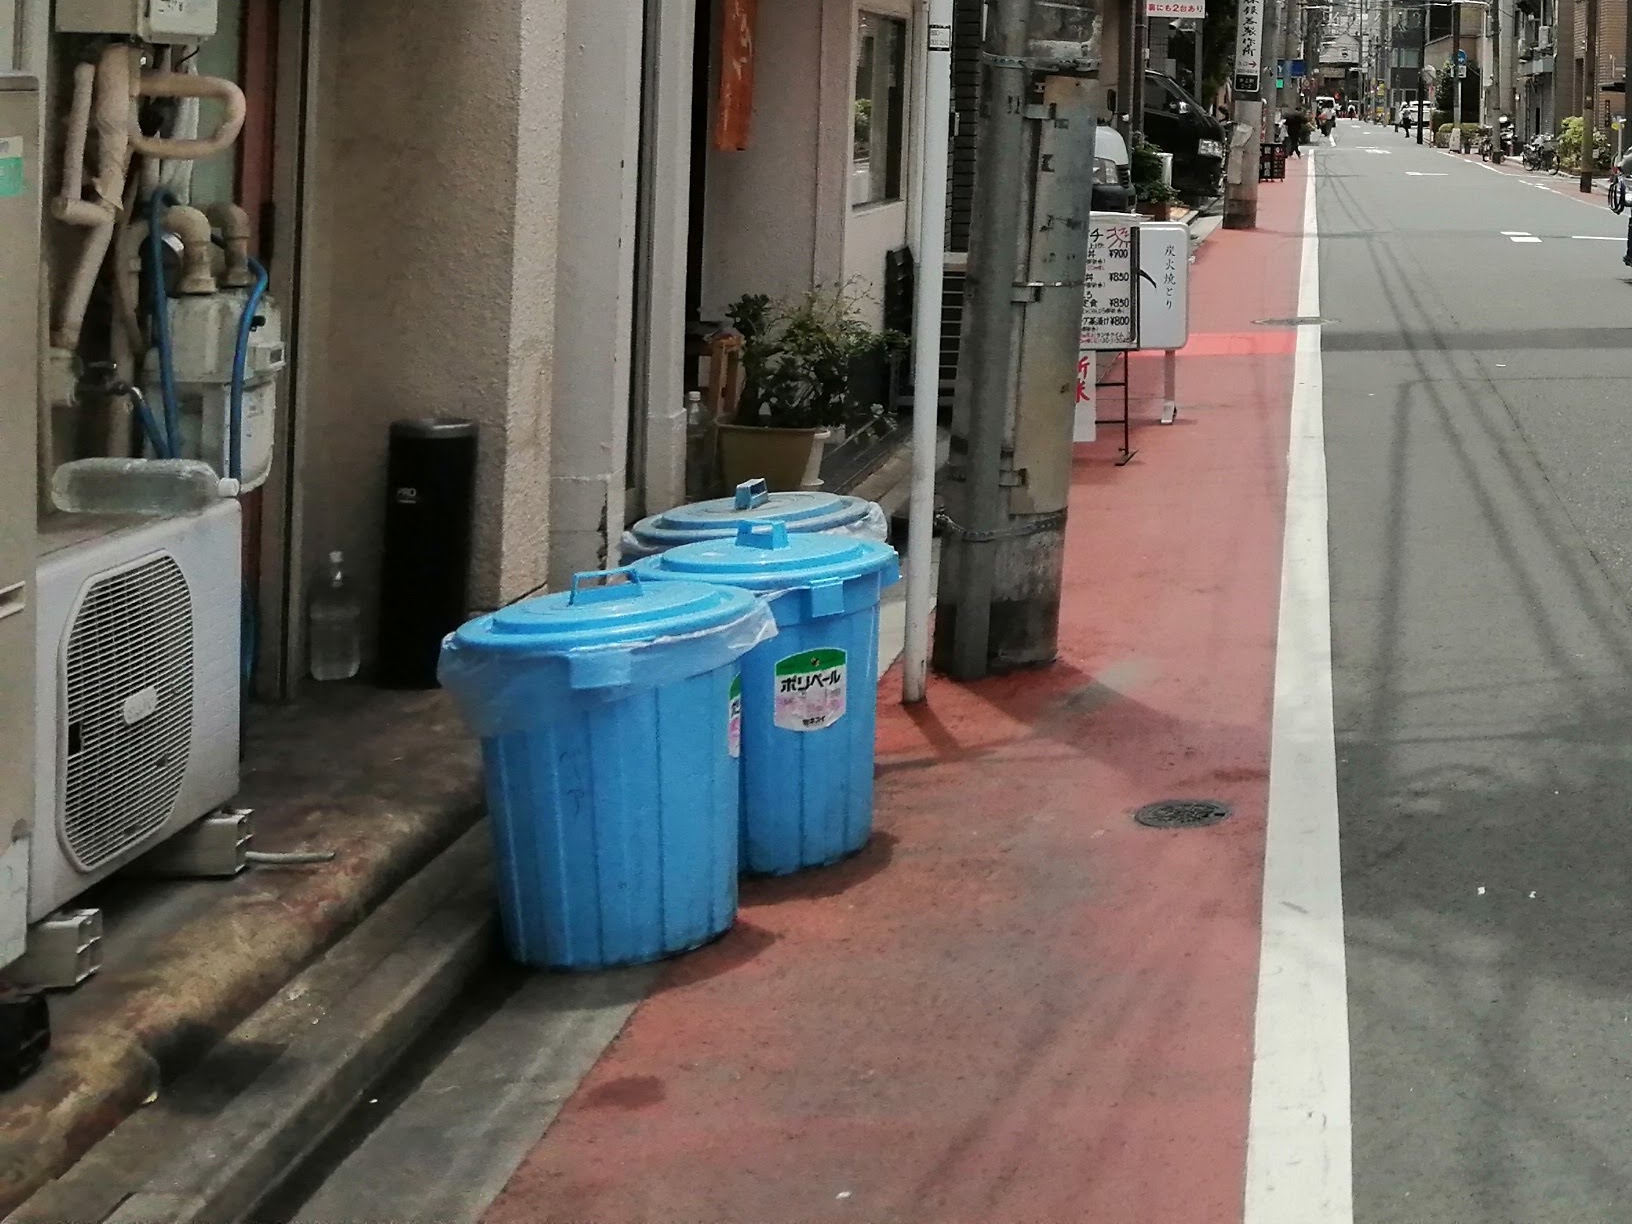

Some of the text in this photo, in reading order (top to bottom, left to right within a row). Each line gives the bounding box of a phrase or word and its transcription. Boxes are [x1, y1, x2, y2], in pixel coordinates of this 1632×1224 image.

[1164, 244, 1177, 310] 炭火焼とり
